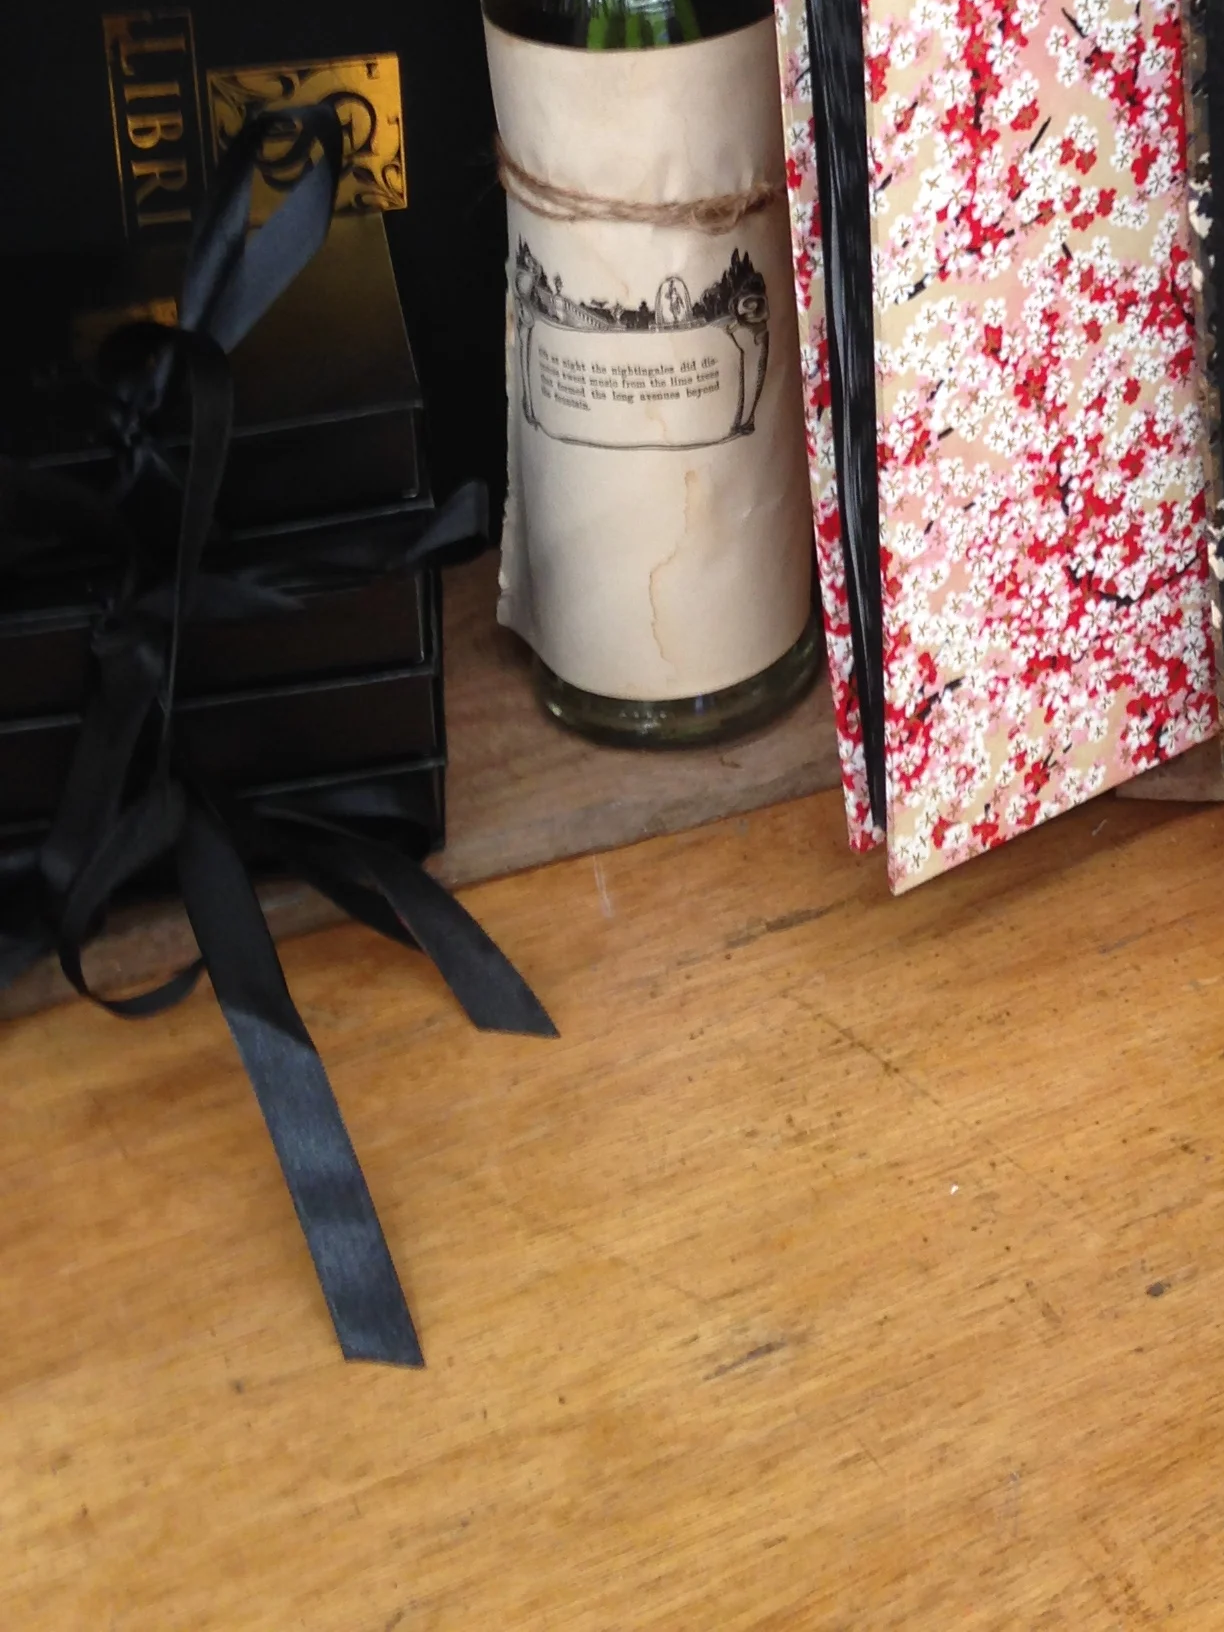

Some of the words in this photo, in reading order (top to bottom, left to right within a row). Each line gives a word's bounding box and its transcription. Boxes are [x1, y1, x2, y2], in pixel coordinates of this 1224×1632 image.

[120, 34, 193, 229] LIBRI
[562, 360, 586, 374] night
[591, 361, 607, 373] the
[611, 362, 675, 379] nightingales
[680, 359, 696, 373] did
[590, 378, 618, 388] music
[622, 379, 646, 389] from
[650, 378, 666, 389] the
[670, 376, 693, 387] lime
[696, 370, 720, 383] trees
[591, 389, 607, 400] the
[612, 390, 635, 405] long
[639, 391, 681, 402] avenues
[686, 380, 720, 400] beyond
